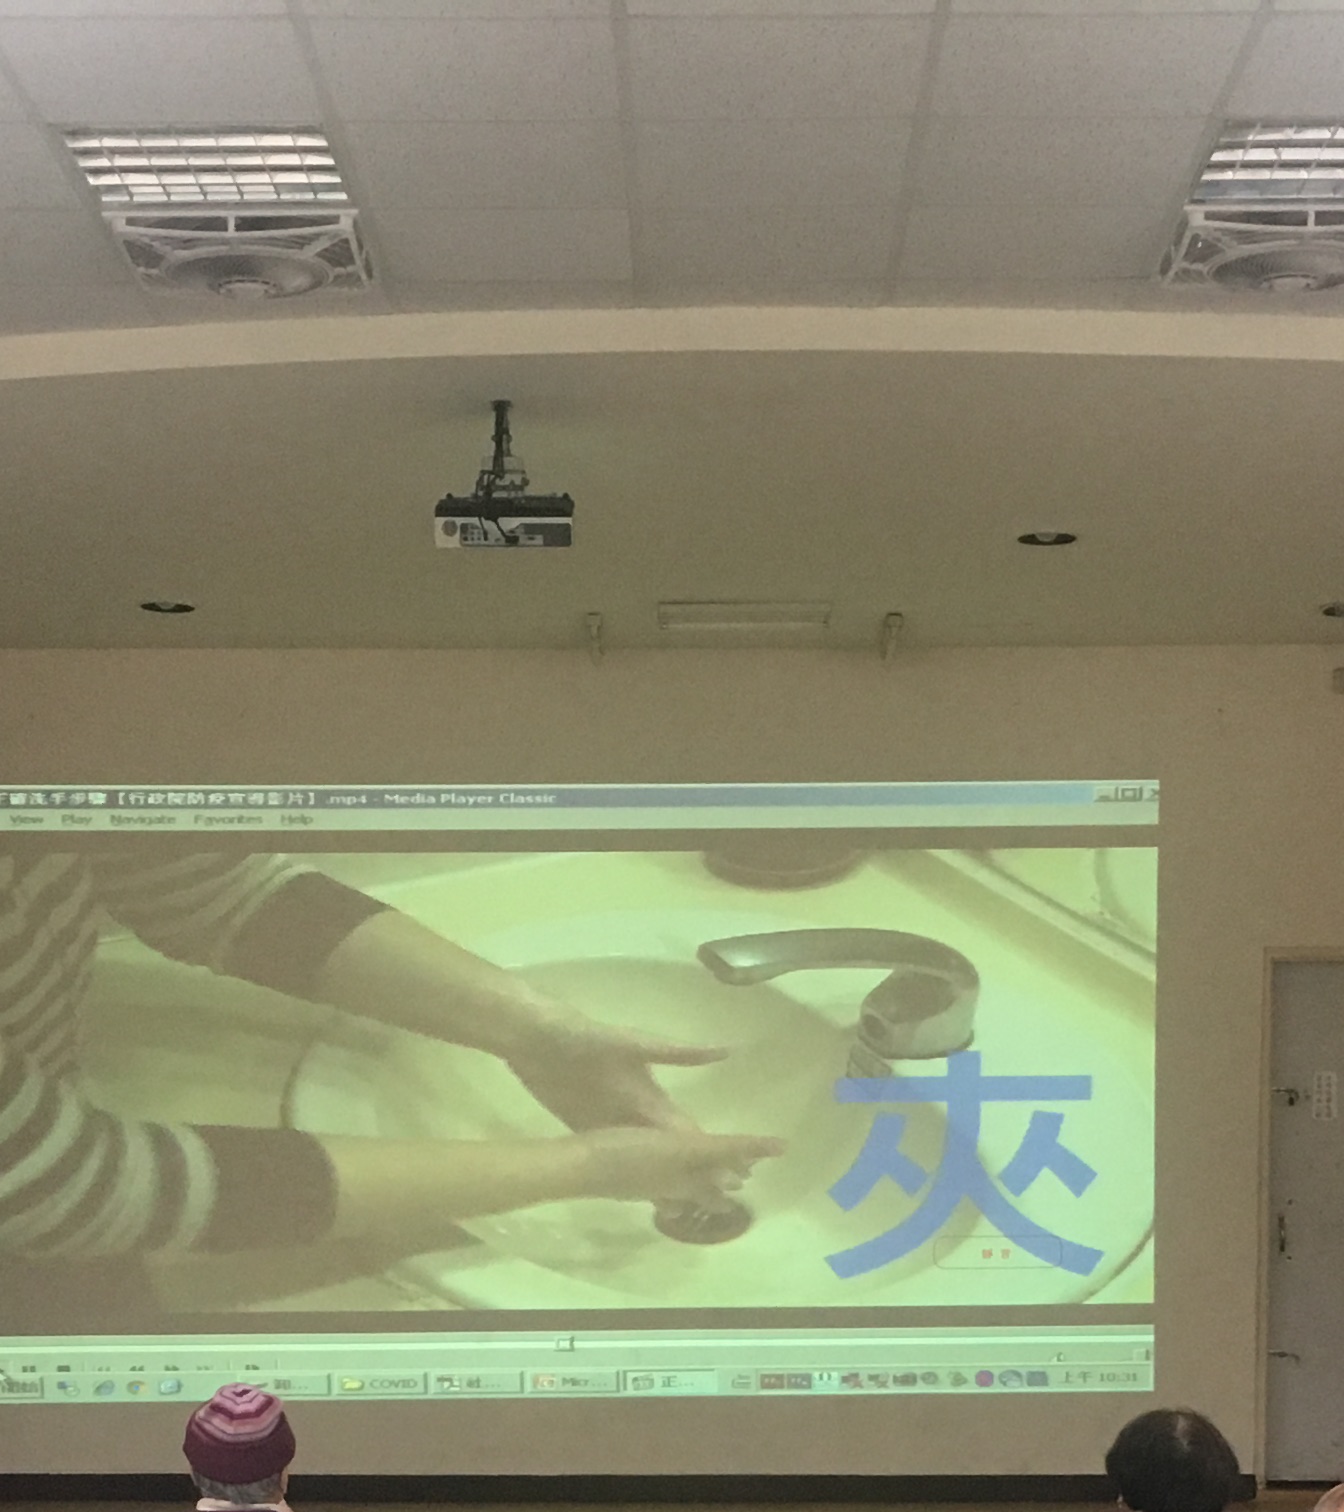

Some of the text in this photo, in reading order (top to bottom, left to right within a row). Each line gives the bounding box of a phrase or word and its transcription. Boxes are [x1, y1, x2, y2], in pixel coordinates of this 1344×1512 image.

[383, 792, 436, 805] Media
[440, 792, 494, 806] Player
[499, 792, 557, 805] Classic
[9, 814, 44, 825] View
[61, 814, 93, 827] Play
[110, 814, 177, 827] Navigate
[193, 814, 263, 826] Favorites
[280, 814, 314, 826] Help
[823, 1049, 1106, 1280] 夾
[369, 1377, 418, 1390] COVID
